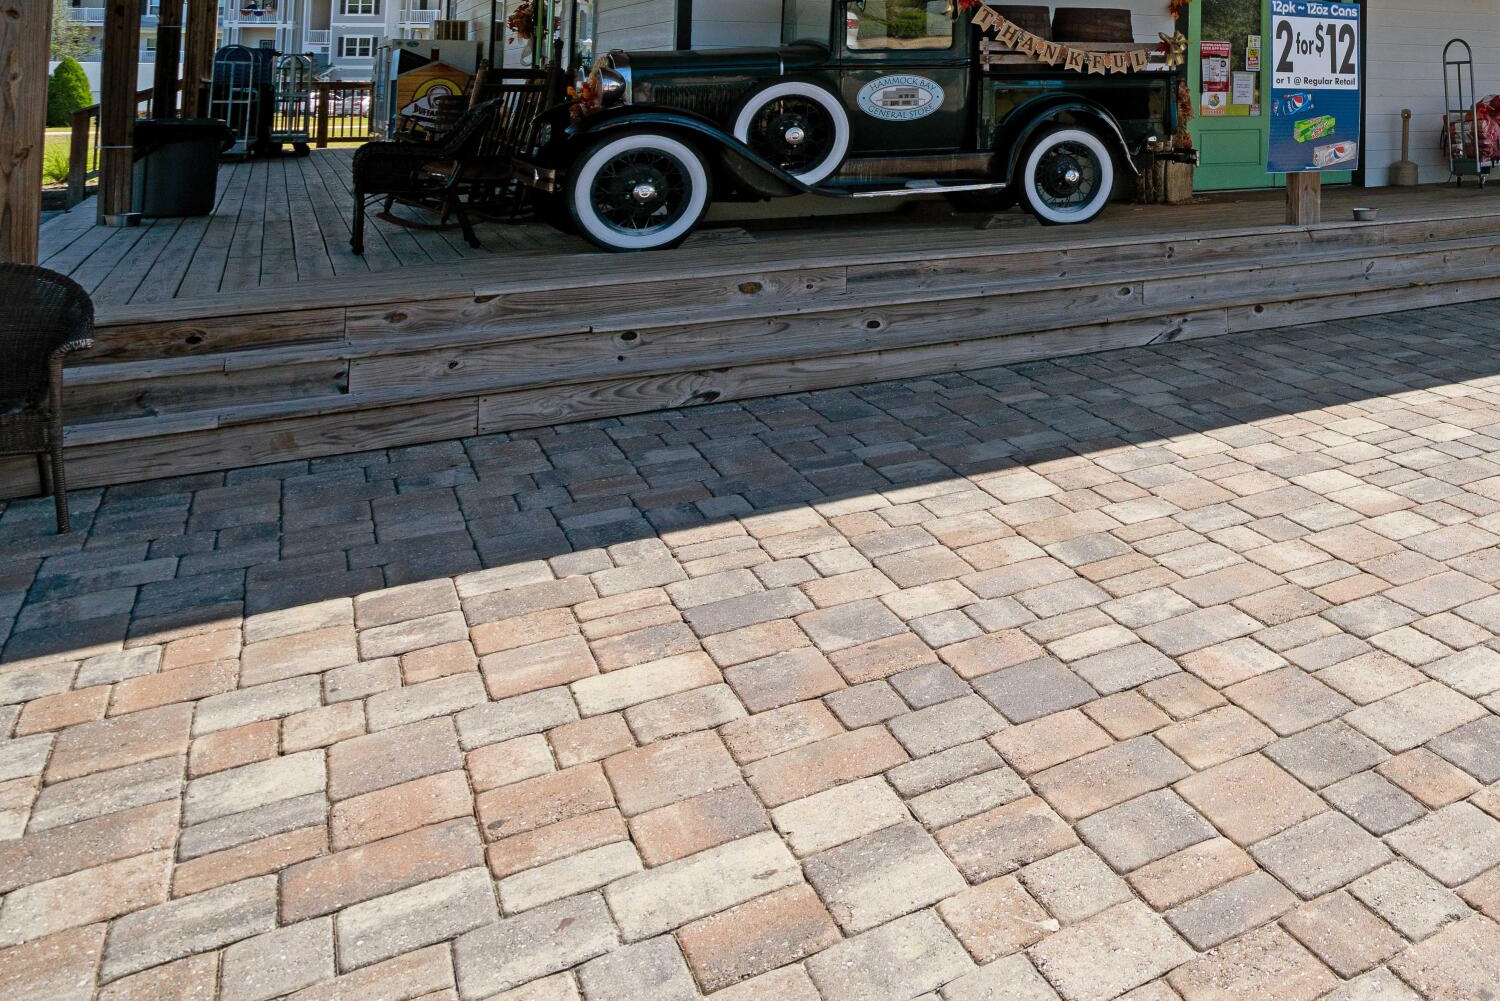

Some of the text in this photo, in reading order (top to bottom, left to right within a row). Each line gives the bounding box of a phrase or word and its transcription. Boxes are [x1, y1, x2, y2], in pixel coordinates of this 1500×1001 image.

[1272, 1, 1296, 14] 12pk
[1306, 3, 1328, 15] 12oz
[1331, 5, 1358, 17] Cans
[1276, 20, 1293, 73] 2
[1296, 32, 1314, 55] for
[869, 76, 936, 92] HAMMOCK BAY
[1304, 77, 1333, 86] Regular
[413, 103, 437, 117] BUFFA
[868, 104, 934, 118] GENERAL STORE
